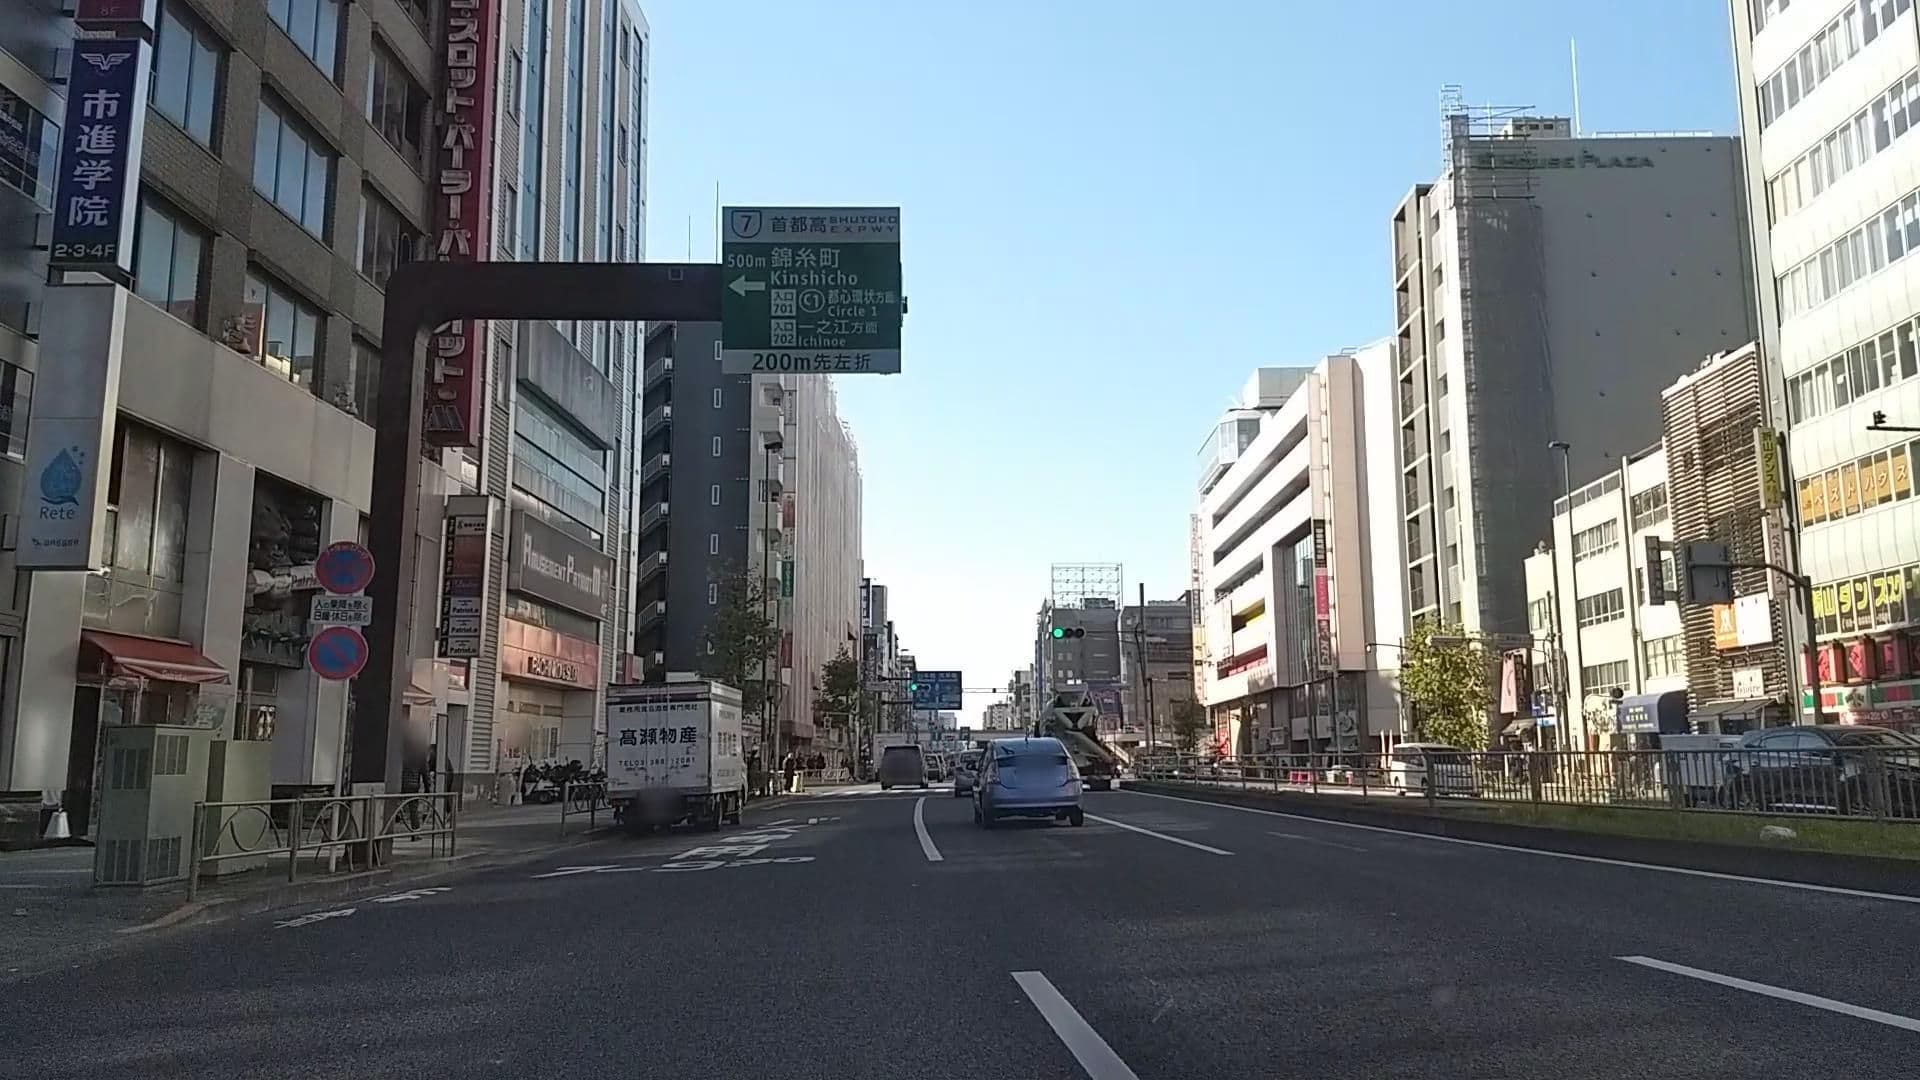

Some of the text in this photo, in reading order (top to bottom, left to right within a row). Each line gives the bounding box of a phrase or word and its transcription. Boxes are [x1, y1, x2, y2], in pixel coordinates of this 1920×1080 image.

[68, 89, 121, 228] 市進学院
[740, 215, 752, 233] 7
[770, 217, 827, 233] 首都高
[829, 216, 898, 224] SHUTOKO
[727, 254, 767, 268] 500m
[770, 247, 842, 268] 錦糸町
[770, 270, 859, 286] Kinshicho
[773, 290, 795, 301] 入口
[828, 289, 896, 304] 都心環状方面
[773, 304, 794, 315] 701
[828, 306, 878, 317] Circle 1
[773, 322, 795, 332] 入口
[798, 320, 879, 335] 一之江方面
[773, 334, 794, 345] 702
[798, 336, 847, 347] Ichinoe
[752, 353, 871, 371] 200m先左折
[1814, 464, 1908, 506] ベストハウス
[40, 506, 75, 520] Rete
[1771, 534, 1784, 584] ベストハス
[619, 726, 698, 747] 高瀬物産
